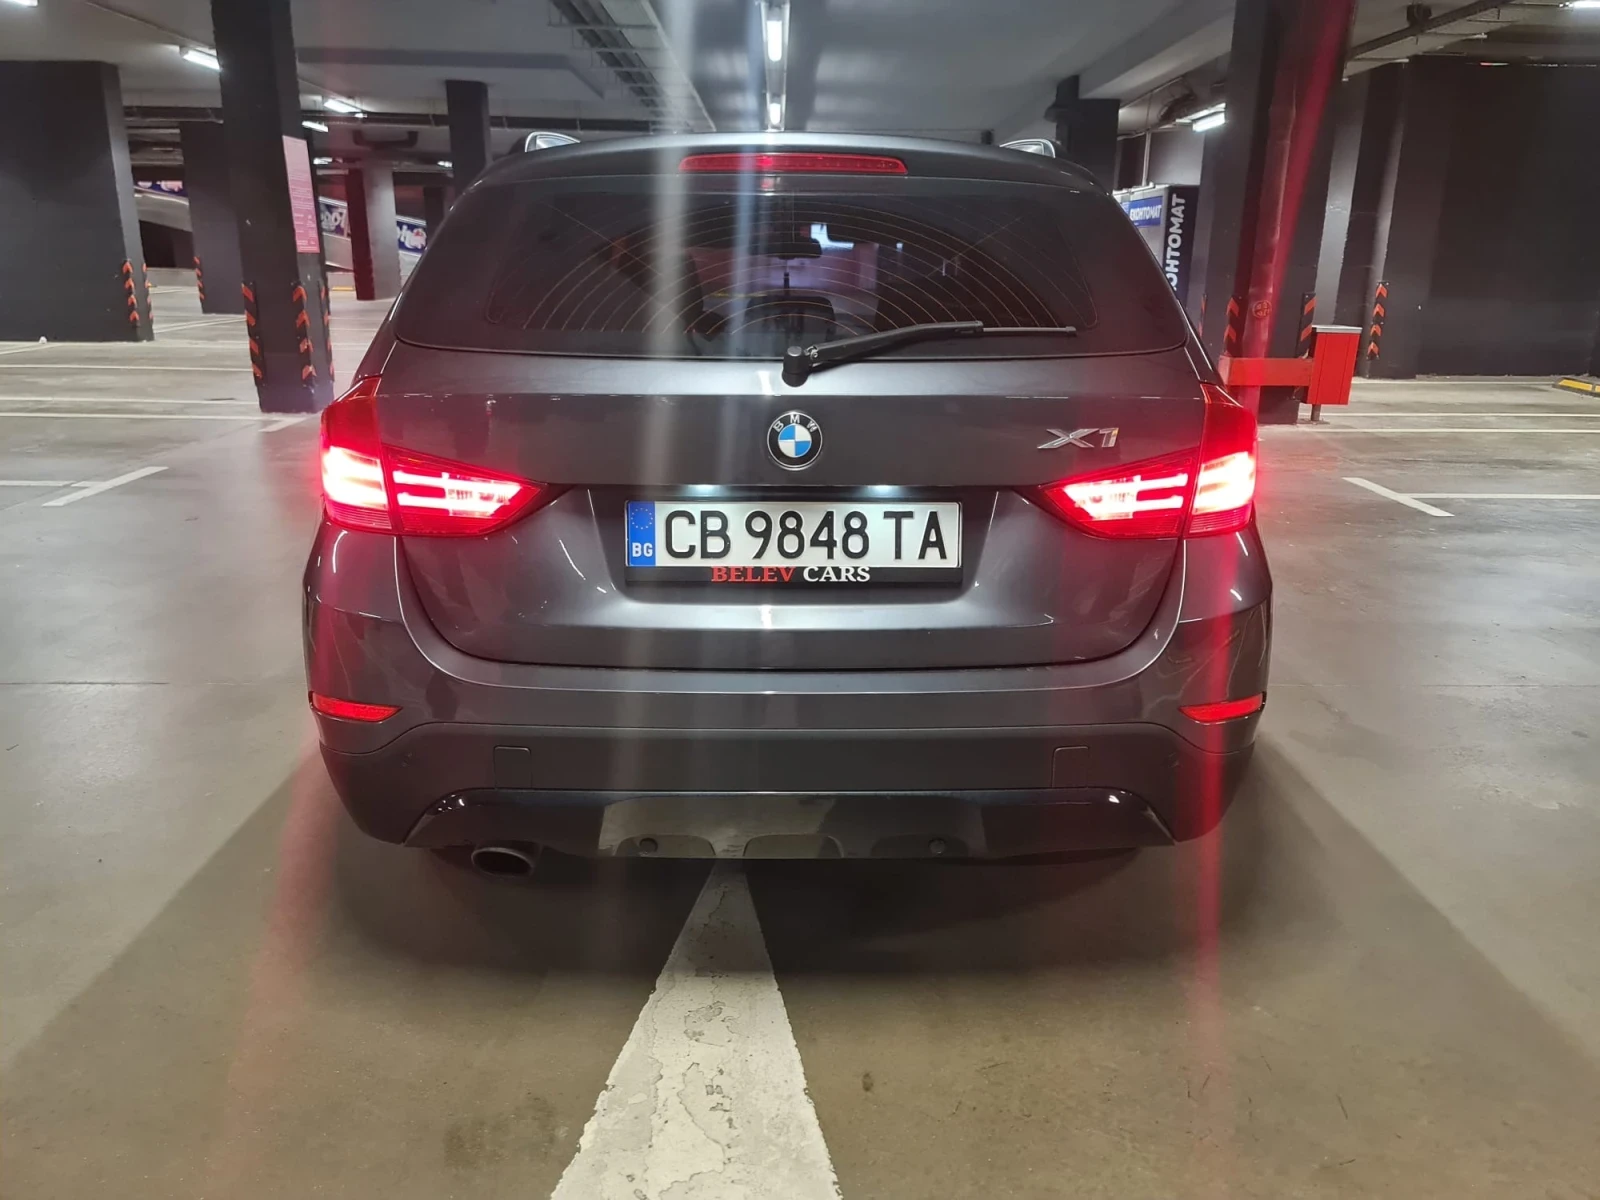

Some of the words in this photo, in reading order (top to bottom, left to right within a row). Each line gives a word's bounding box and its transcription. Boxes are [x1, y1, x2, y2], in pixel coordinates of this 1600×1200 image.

[1165, 193, 1186, 292] ОНТОМАТ
[772, 413, 819, 433] BMW
[1037, 427, 1120, 449] X1
[665, 510, 732, 560] CB
[745, 510, 870, 560] 9848
[883, 510, 948, 560] TA
[631, 542, 654, 558] BG
[711, 566, 796, 583] BELEV
[803, 565, 871, 583] CARS
